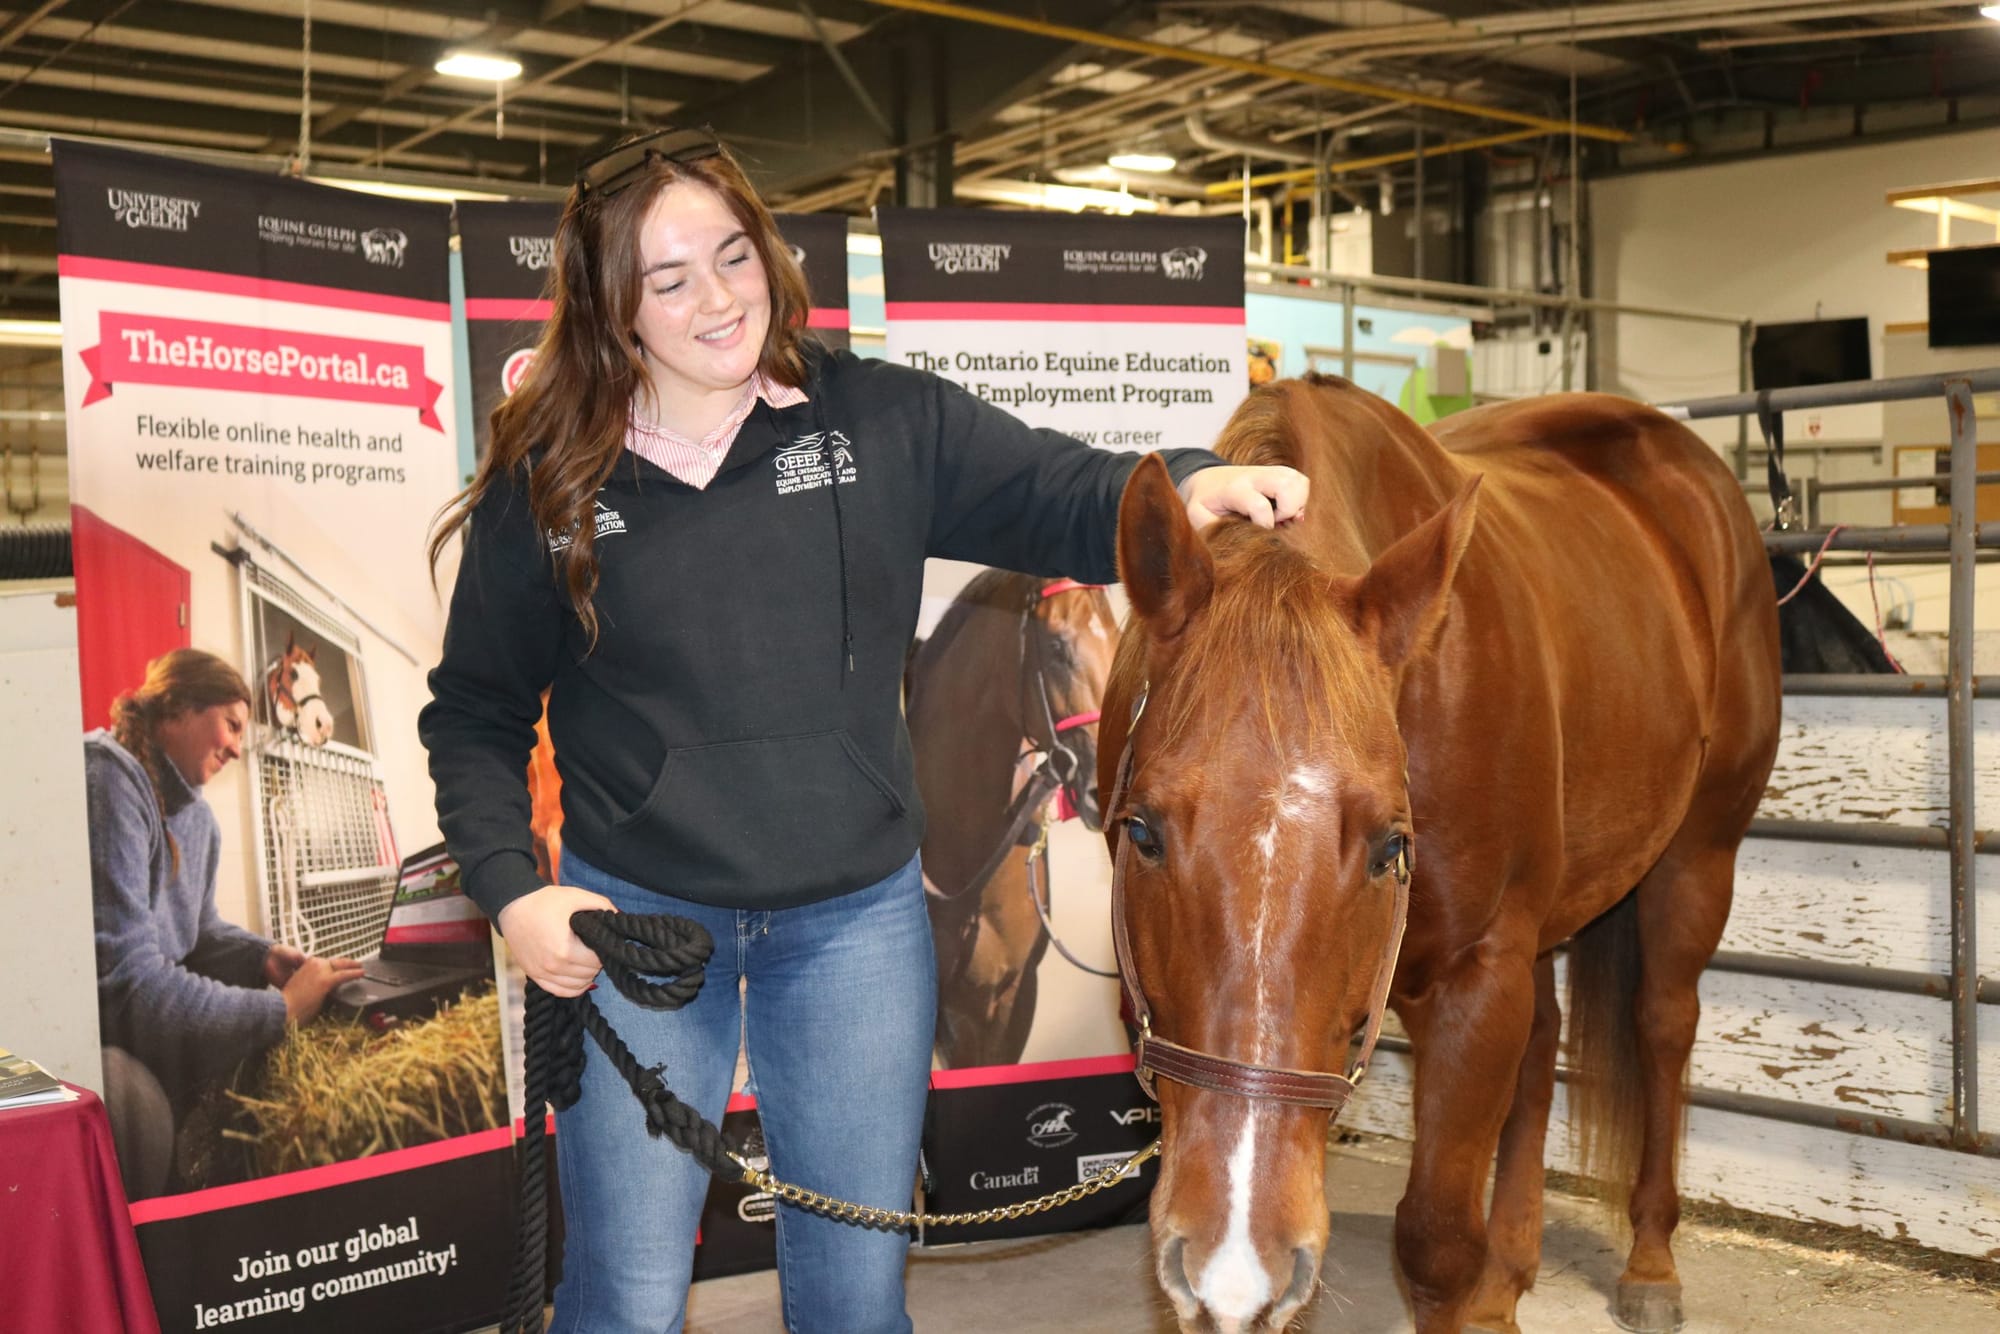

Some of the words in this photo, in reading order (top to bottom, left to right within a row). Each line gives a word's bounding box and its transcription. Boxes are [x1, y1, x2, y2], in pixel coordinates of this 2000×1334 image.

[107, 187, 201, 218] UNIVERSITY
[126, 207, 187, 231] GUELPH
[258, 215, 305, 235] EQUINE
[308, 223, 357, 243] GUELPH
[928, 243, 1012, 261] UNIVERSITY
[1063, 249, 1107, 263] EQUINE
[1110, 251, 1157, 263] GUELPH
[944, 256, 1000, 274] GUELPH
[122, 329, 410, 390] TheHorsePortal.ca
[906, 351, 949, 372] The
[955, 351, 1039, 372] Ontario
[1045, 352, 1119, 376] Equine
[1126, 352, 1231, 373] Education
[977, 382, 1115, 408] Employment
[1123, 384, 1213, 408] Program
[137, 414, 220, 441] Flexible
[226, 422, 291, 446] online
[298, 426, 360, 451] health
[366, 432, 402, 453] and
[1103, 431, 1163, 445] career
[136, 449, 218, 473] welfare
[225, 455, 306, 483] training
[312, 464, 405, 485] programs
[776, 453, 821, 471] OEEEP
[783, 470, 797, 478] THE
[797, 465, 825, 475] ONTARIO
[776, 476, 801, 488] EQUINE
[842, 467, 857, 476] AND
[778, 480, 822, 495] EMPLOYMENT
[970, 1169, 1040, 1190] Canada
[233, 1249, 291, 1283] Join
[297, 1241, 339, 1268] our
[345, 1217, 419, 1263] global
[195, 1288, 306, 1329] learning
[311, 1244, 458, 1302] community!
